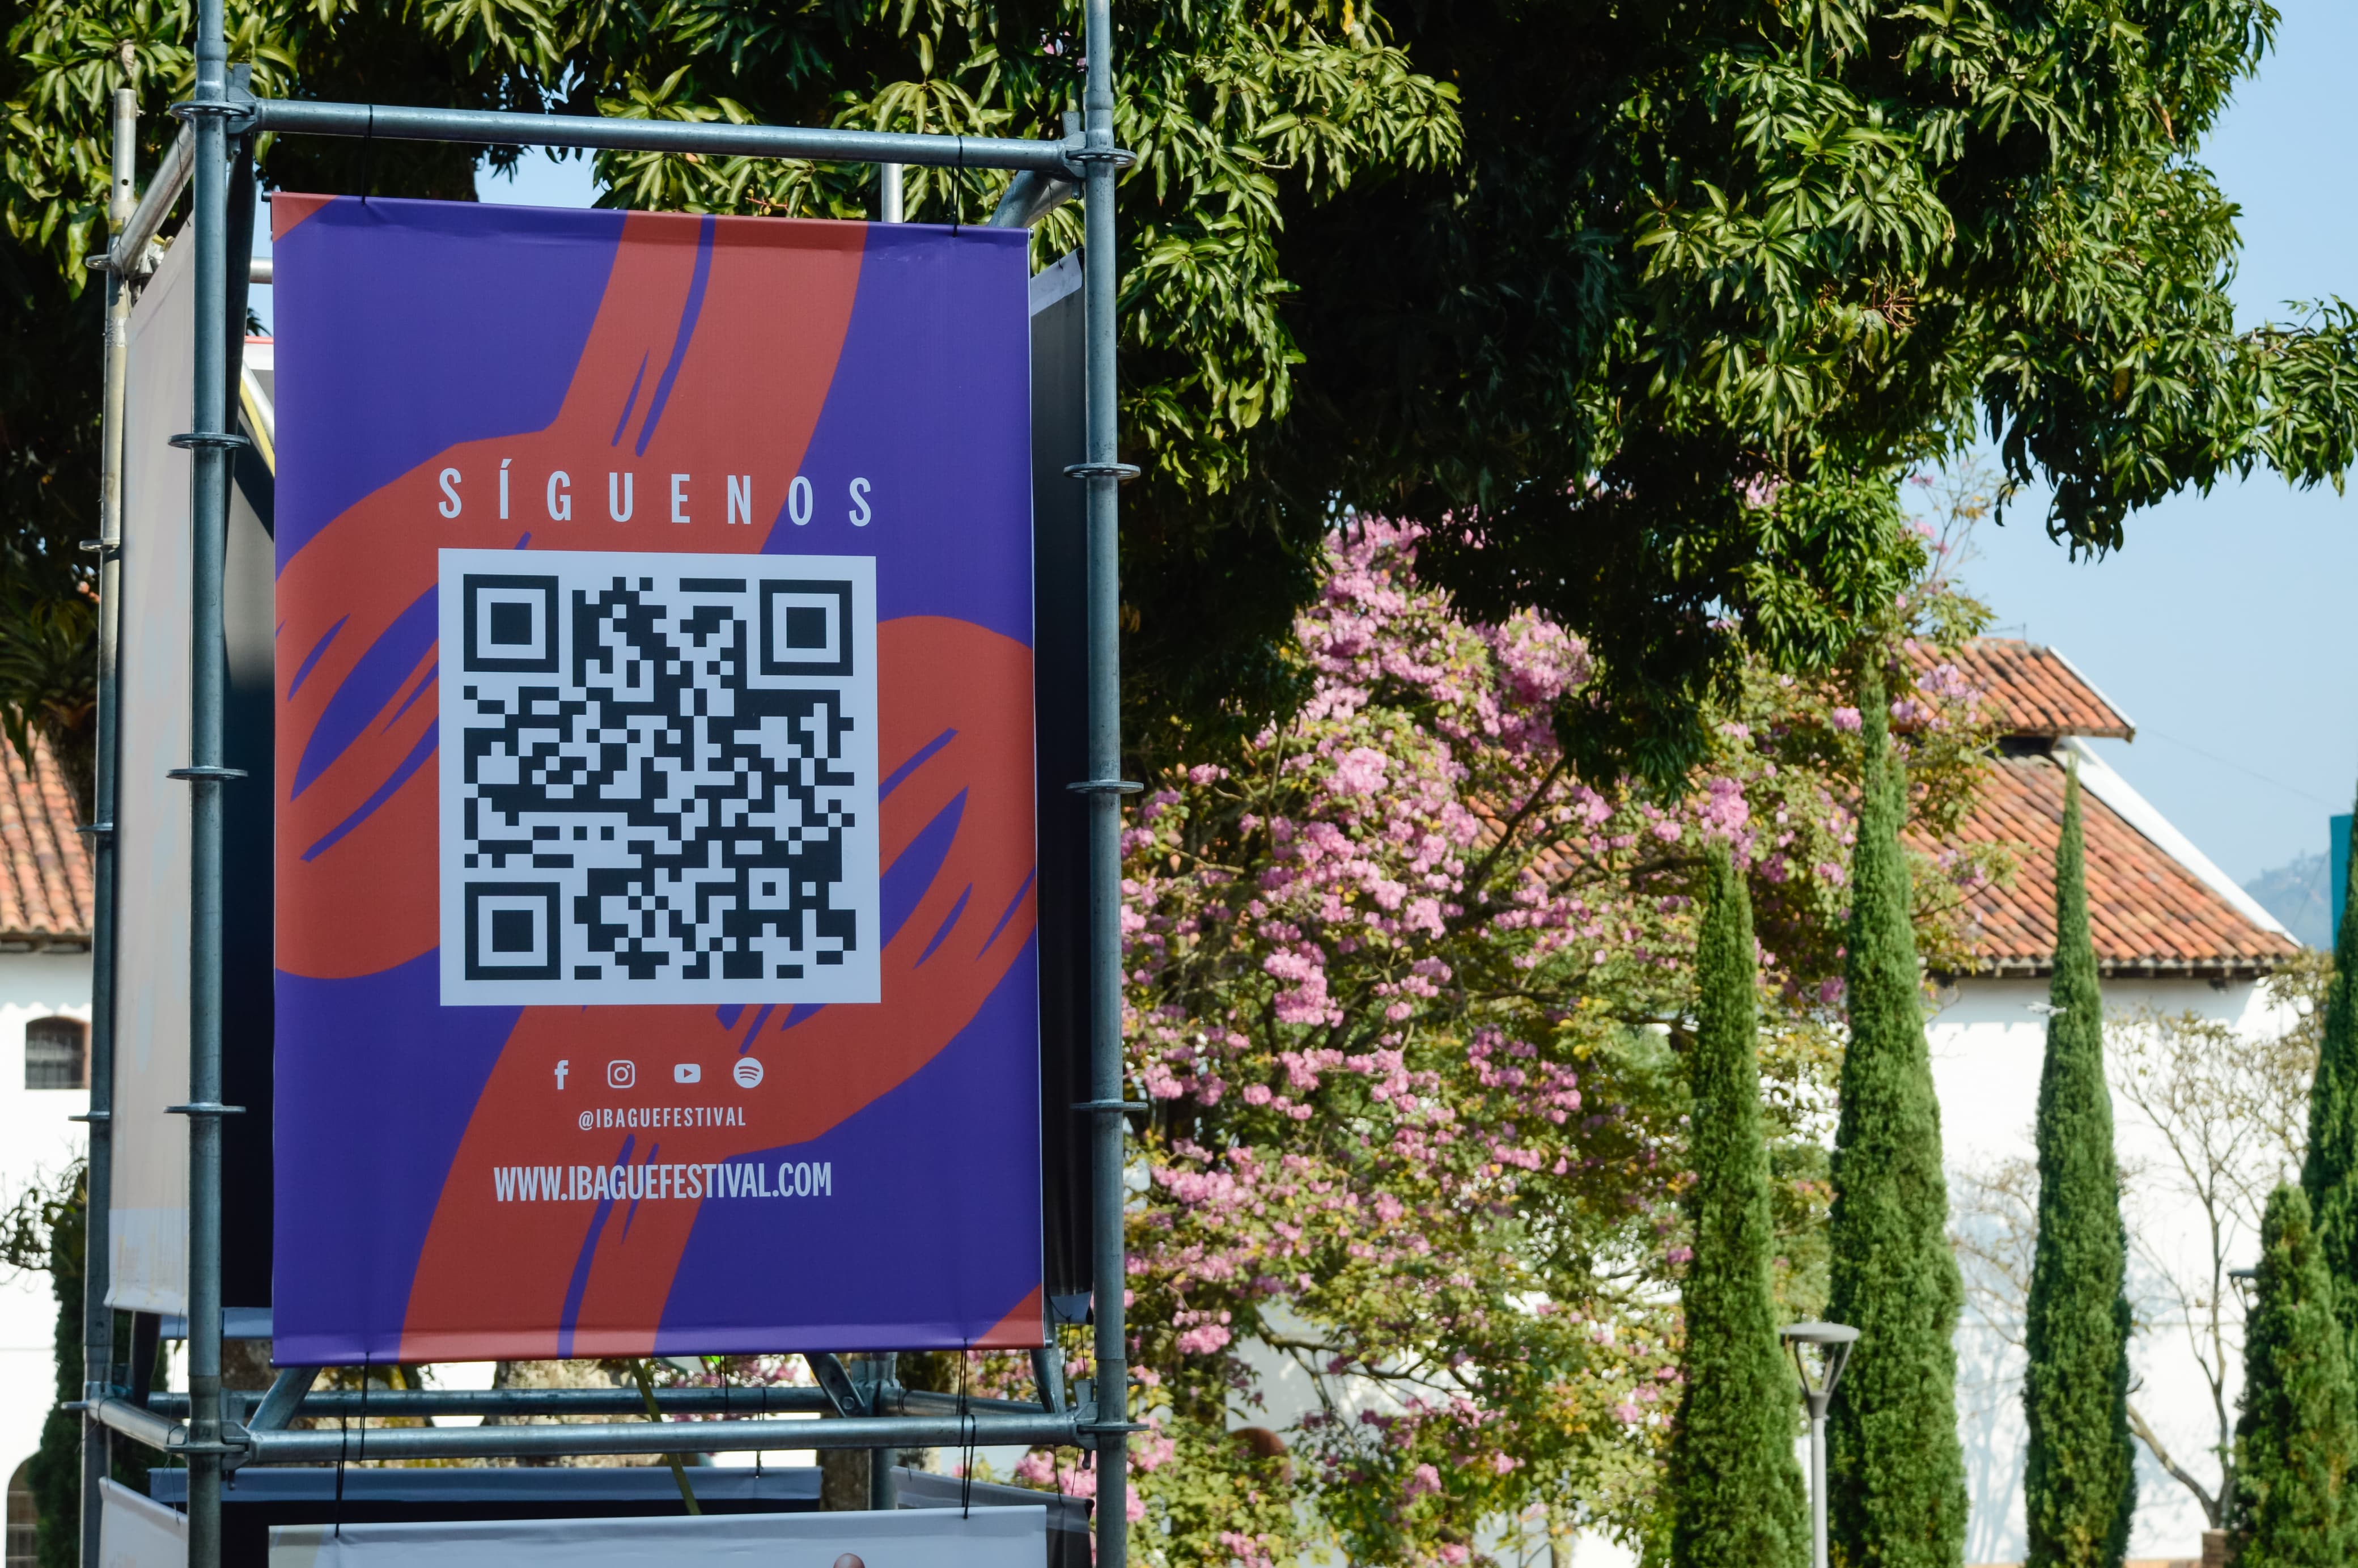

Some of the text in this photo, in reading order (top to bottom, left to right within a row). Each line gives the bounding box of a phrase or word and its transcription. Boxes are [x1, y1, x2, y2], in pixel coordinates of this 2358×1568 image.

[438, 458, 871, 527] SÍGUENOS
[578, 1107, 746, 1131] @IBAGUEFESTIVAL
[493, 1162, 832, 1202] WWW.IBAGUEFESTIVAL.COM
